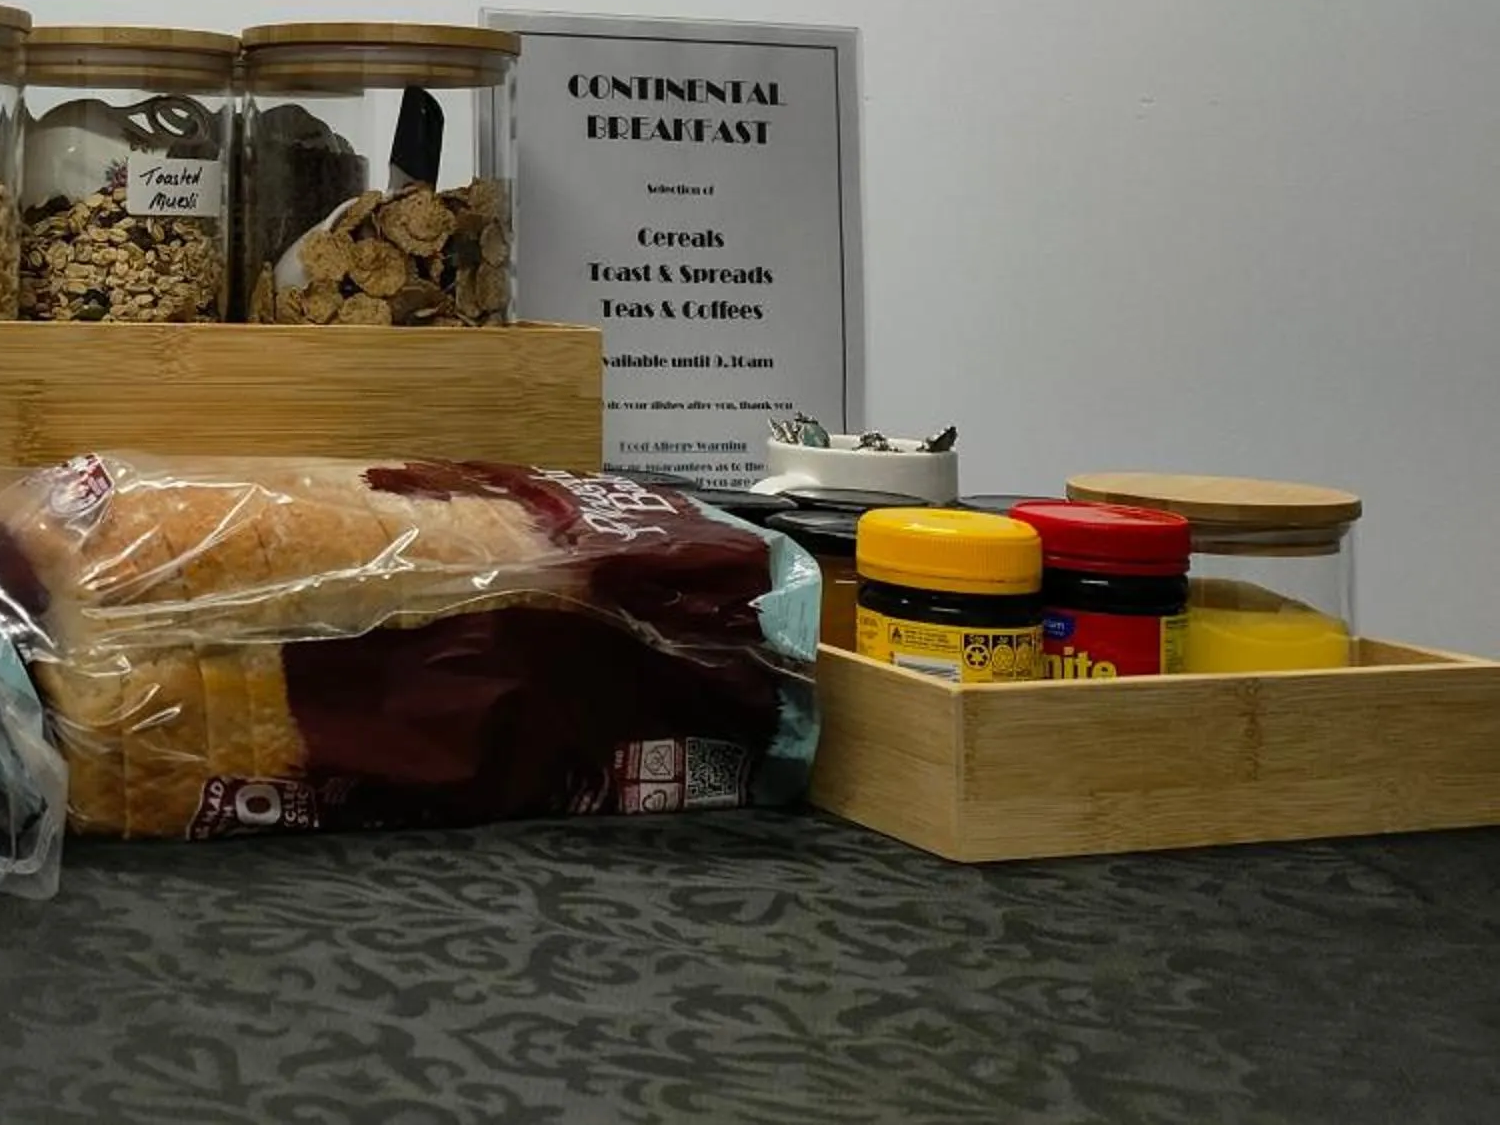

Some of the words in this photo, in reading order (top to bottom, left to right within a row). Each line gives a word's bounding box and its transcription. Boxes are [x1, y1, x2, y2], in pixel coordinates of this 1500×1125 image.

[568, 74, 788, 106] CONTINENTAL
[587, 114, 771, 144] BREAKFAST
[139, 166, 203, 186] Toasted
[647, 183, 700, 195] Selection
[703, 185, 714, 195] of
[148, 192, 199, 211] Muesli
[637, 228, 725, 248] Cereals
[588, 262, 651, 282] Toast
[658, 265, 673, 283] &
[680, 265, 773, 284] Spreads
[601, 299, 654, 318] Teas
[660, 301, 676, 318] &
[682, 301, 763, 319] Coffees
[602, 355, 668, 368] vailable
[671, 355, 710, 368] until
[739, 401, 772, 410] thank
